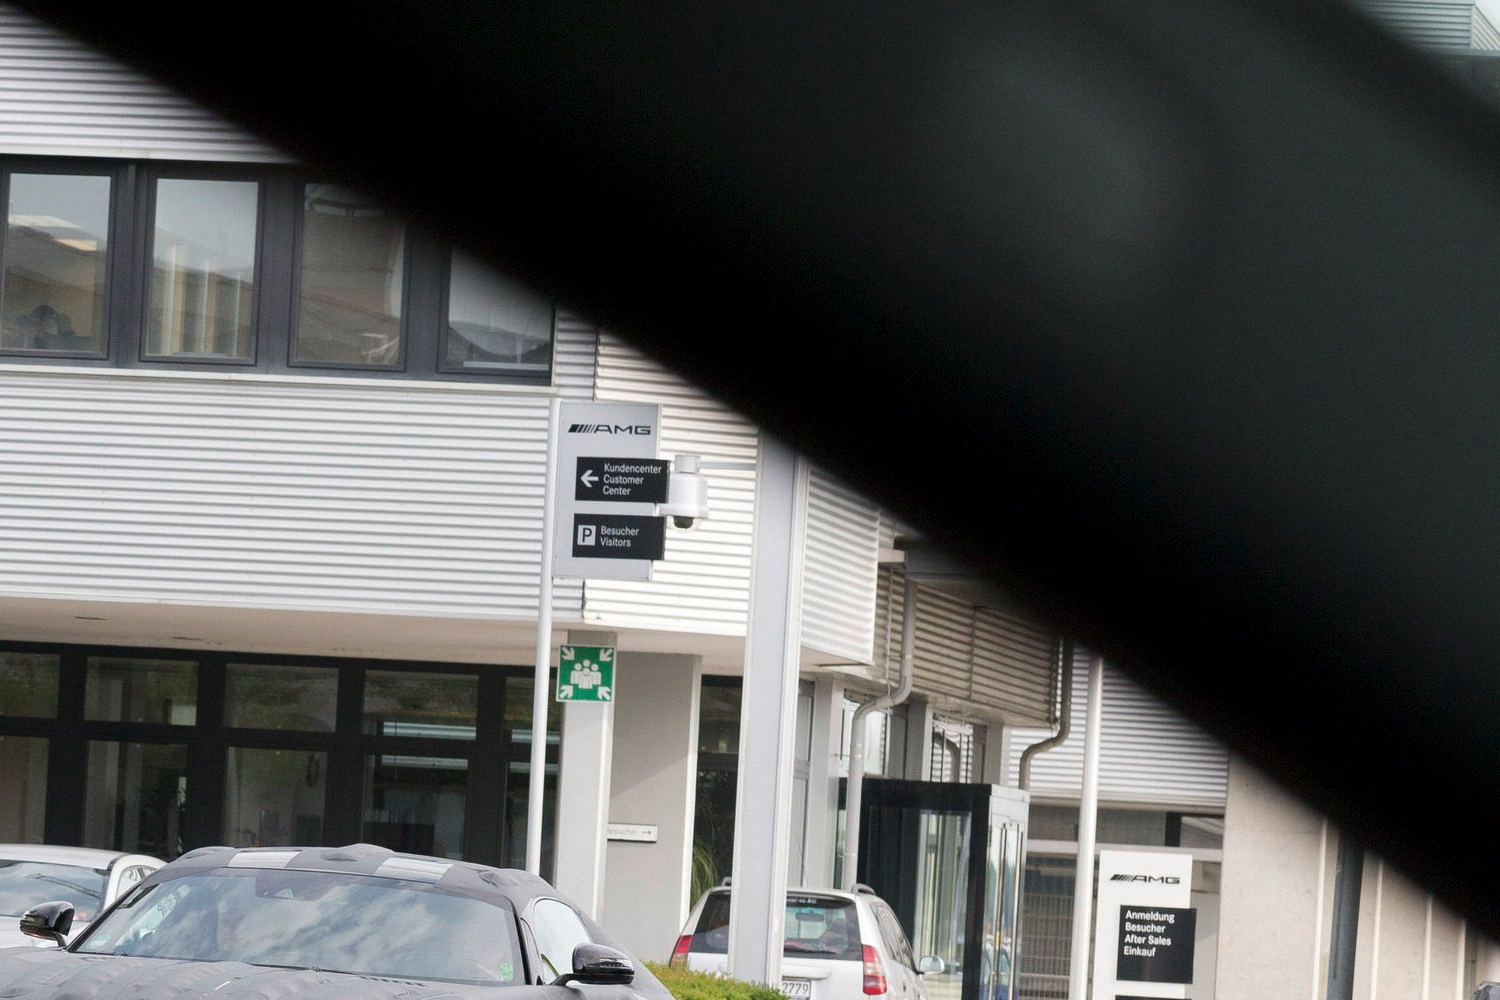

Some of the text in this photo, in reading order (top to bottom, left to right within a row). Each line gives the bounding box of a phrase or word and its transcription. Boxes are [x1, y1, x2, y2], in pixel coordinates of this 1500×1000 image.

[594, 424, 651, 435] AMG
[604, 463, 662, 474] Kundencenter
[603, 476, 644, 485] Customer
[603, 486, 631, 495] Center
[601, 526, 639, 536] Besucher
[600, 538, 631, 547] Visitors
[1132, 875, 1180, 884] AMG
[1125, 910, 1175, 924] Anmeldung
[1125, 922, 1166, 933] Besucher
[1124, 934, 1172, 946] After Sales
[1123, 946, 1156, 957] Einkauf
[782, 982, 809, 995] 2779
